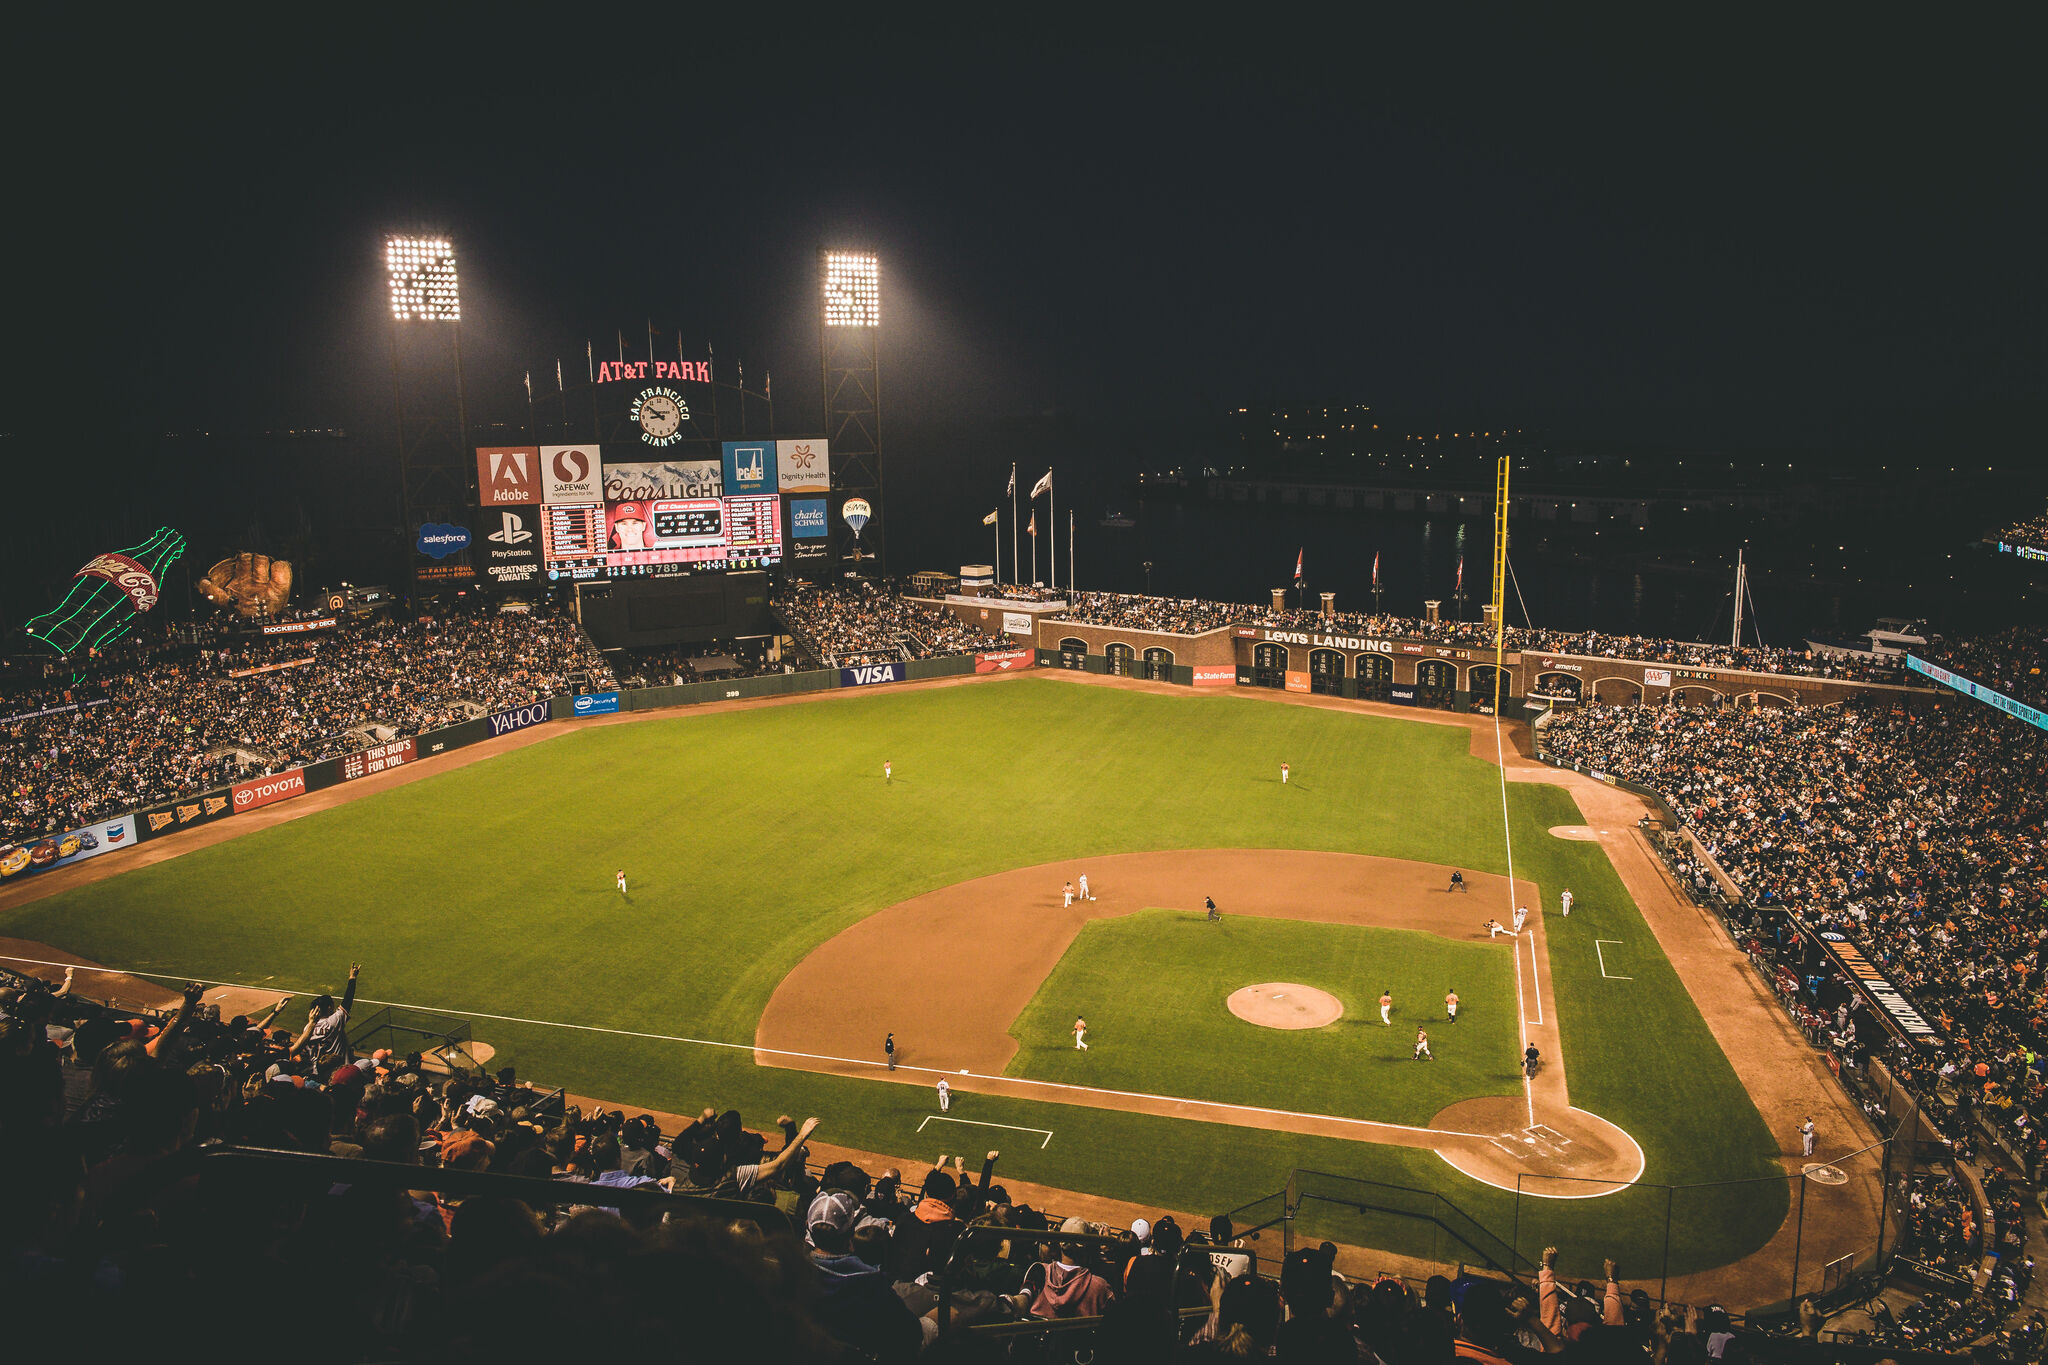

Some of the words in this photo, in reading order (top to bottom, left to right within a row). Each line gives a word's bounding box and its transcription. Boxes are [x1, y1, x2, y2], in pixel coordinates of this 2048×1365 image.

[597, 361, 648, 383] AT&T
[655, 361, 710, 383] PARK
[630, 398, 643, 421] SAN
[640, 387, 690, 420] FRANCISCO
[641, 432, 682, 447] GIANTS
[737, 467, 763, 480] PG&E
[782, 473, 804, 481] Dignity
[494, 489, 529, 501] Adobe
[604, 479, 667, 500] Coors
[671, 483, 722, 498] LIGHT
[794, 509, 823, 520] charles
[423, 534, 466, 544] salesforce
[492, 550, 532, 558] PlayStation
[2017, 546, 2024, 557] 91
[488, 564, 538, 575] GREATNESS
[646, 566, 653, 574] 6
[656, 565, 662, 573] 7
[664, 564, 670, 572] 8
[671, 564, 678, 572] 9
[740, 560, 747, 568] 0
[264, 624, 304, 633] DOCKERS
[1314, 634, 1392, 652] LANDING
[1555, 663, 1582, 672] america
[851, 665, 895, 685] VISA
[1646, 671, 1662, 680] AAA
[726, 690, 740, 698] 399
[491, 701, 548, 735] YAHOO!
[367, 747, 386, 760] THIS
[387, 740, 411, 755] BUD'S
[368, 760, 385, 773] FOR
[386, 754, 404, 768] YOU.
[254, 776, 304, 798] TOYOTA
[106, 823, 124, 831] Chevron
[1863, 981, 1895, 991] TO
[1875, 991, 1935, 1033] WELCOME
